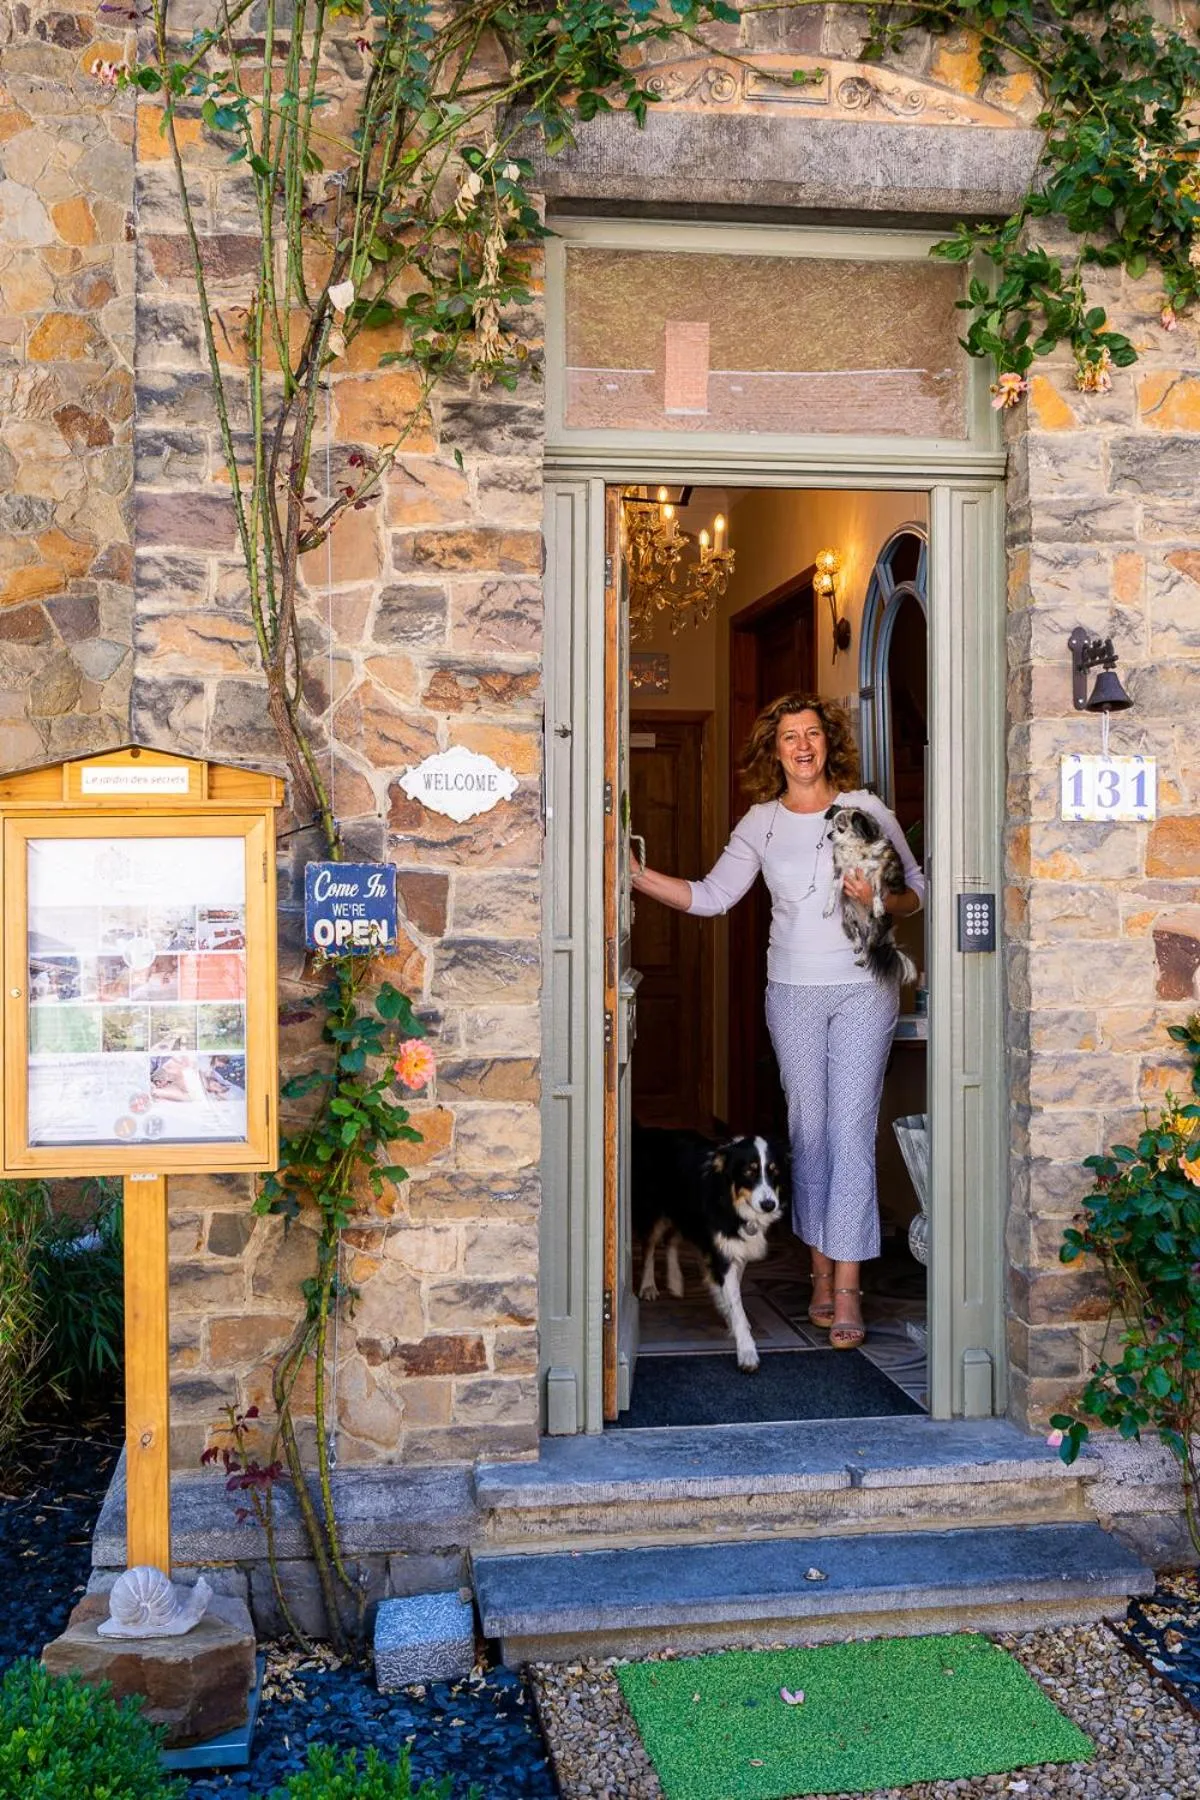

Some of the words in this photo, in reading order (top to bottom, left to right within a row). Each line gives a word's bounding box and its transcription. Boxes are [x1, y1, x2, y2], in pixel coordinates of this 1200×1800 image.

[130, 775, 148, 784] des
[150, 775, 186, 784] secrets
[423, 773, 498, 792] WELCOME
[1068, 769, 1148, 808] 131
[314, 870, 360, 902] Come
[362, 873, 389, 899] In
[332, 903, 366, 917] WE'RE
[313, 918, 389, 947] OPEN
